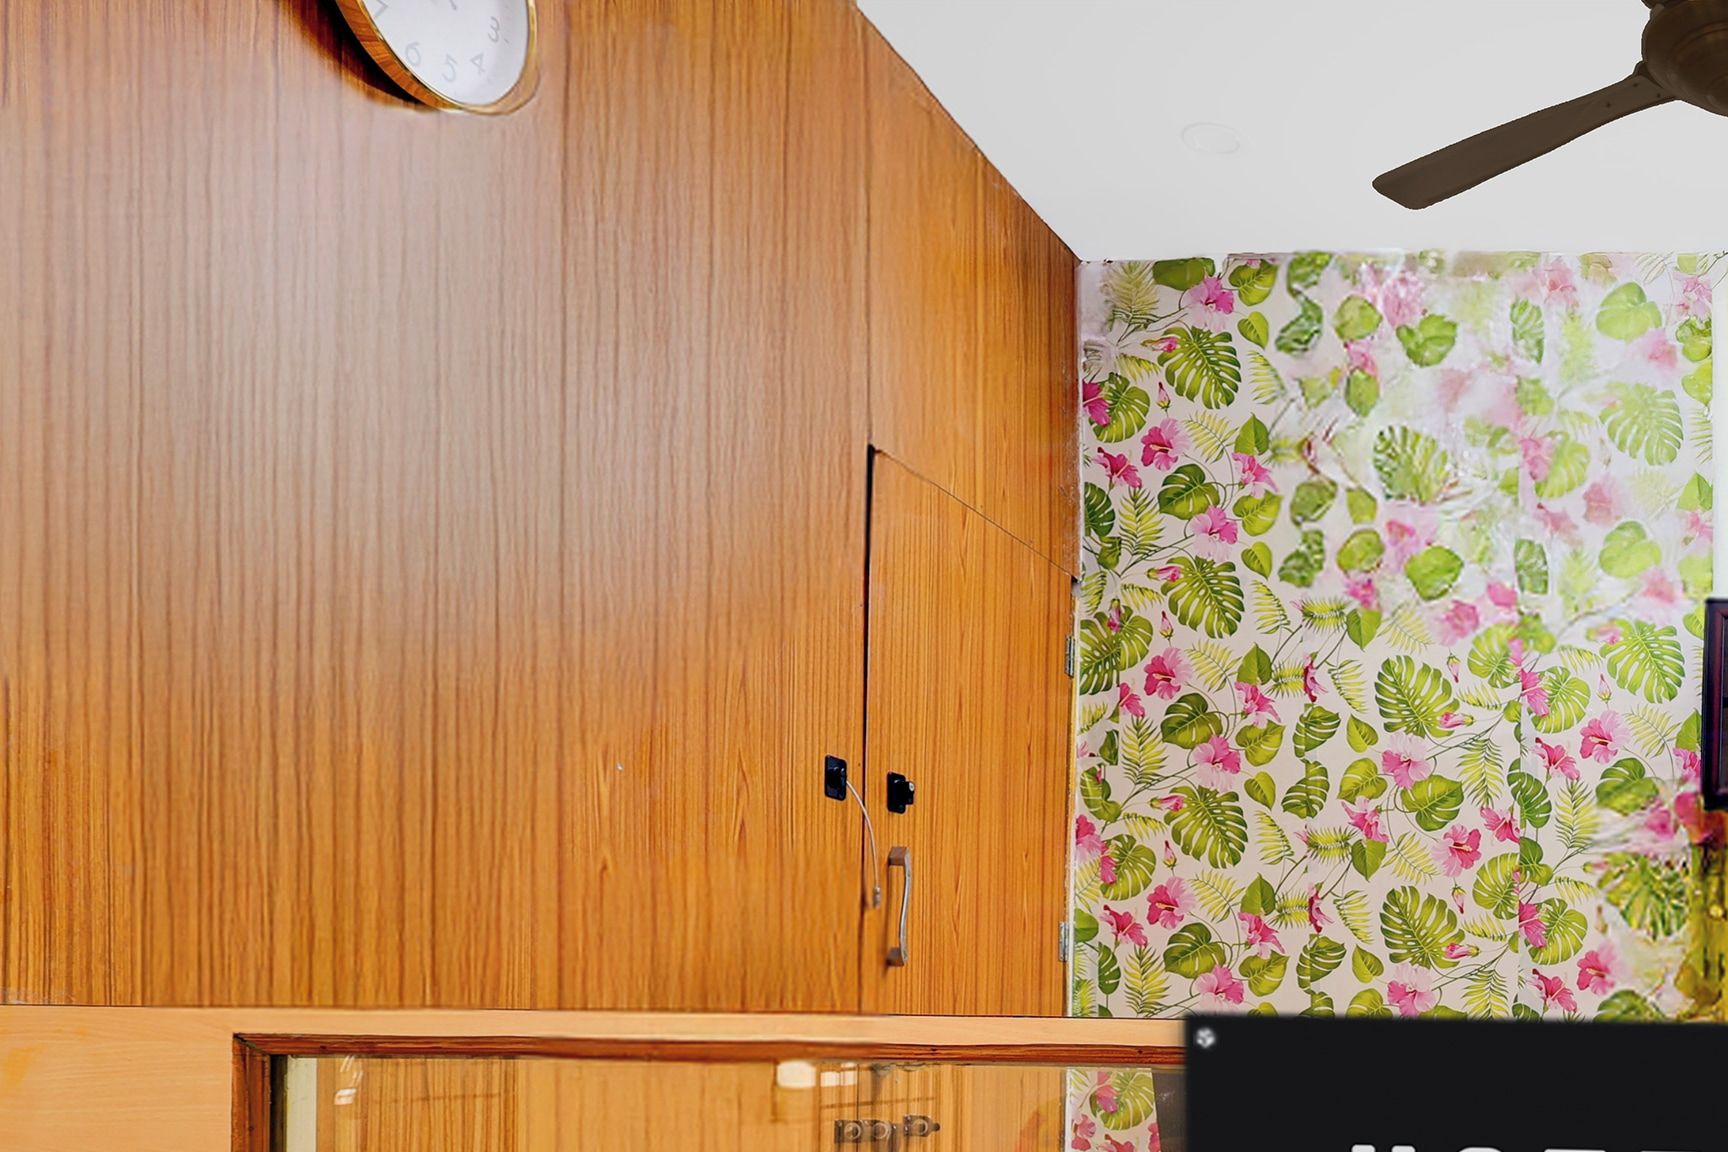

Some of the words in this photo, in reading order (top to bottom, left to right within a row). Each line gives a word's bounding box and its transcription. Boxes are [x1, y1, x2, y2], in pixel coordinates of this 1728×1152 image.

[487, 15, 501, 43] 3
[404, 40, 422, 67] 6
[469, 52, 485, 75] 4
[441, 53, 457, 82] 5
